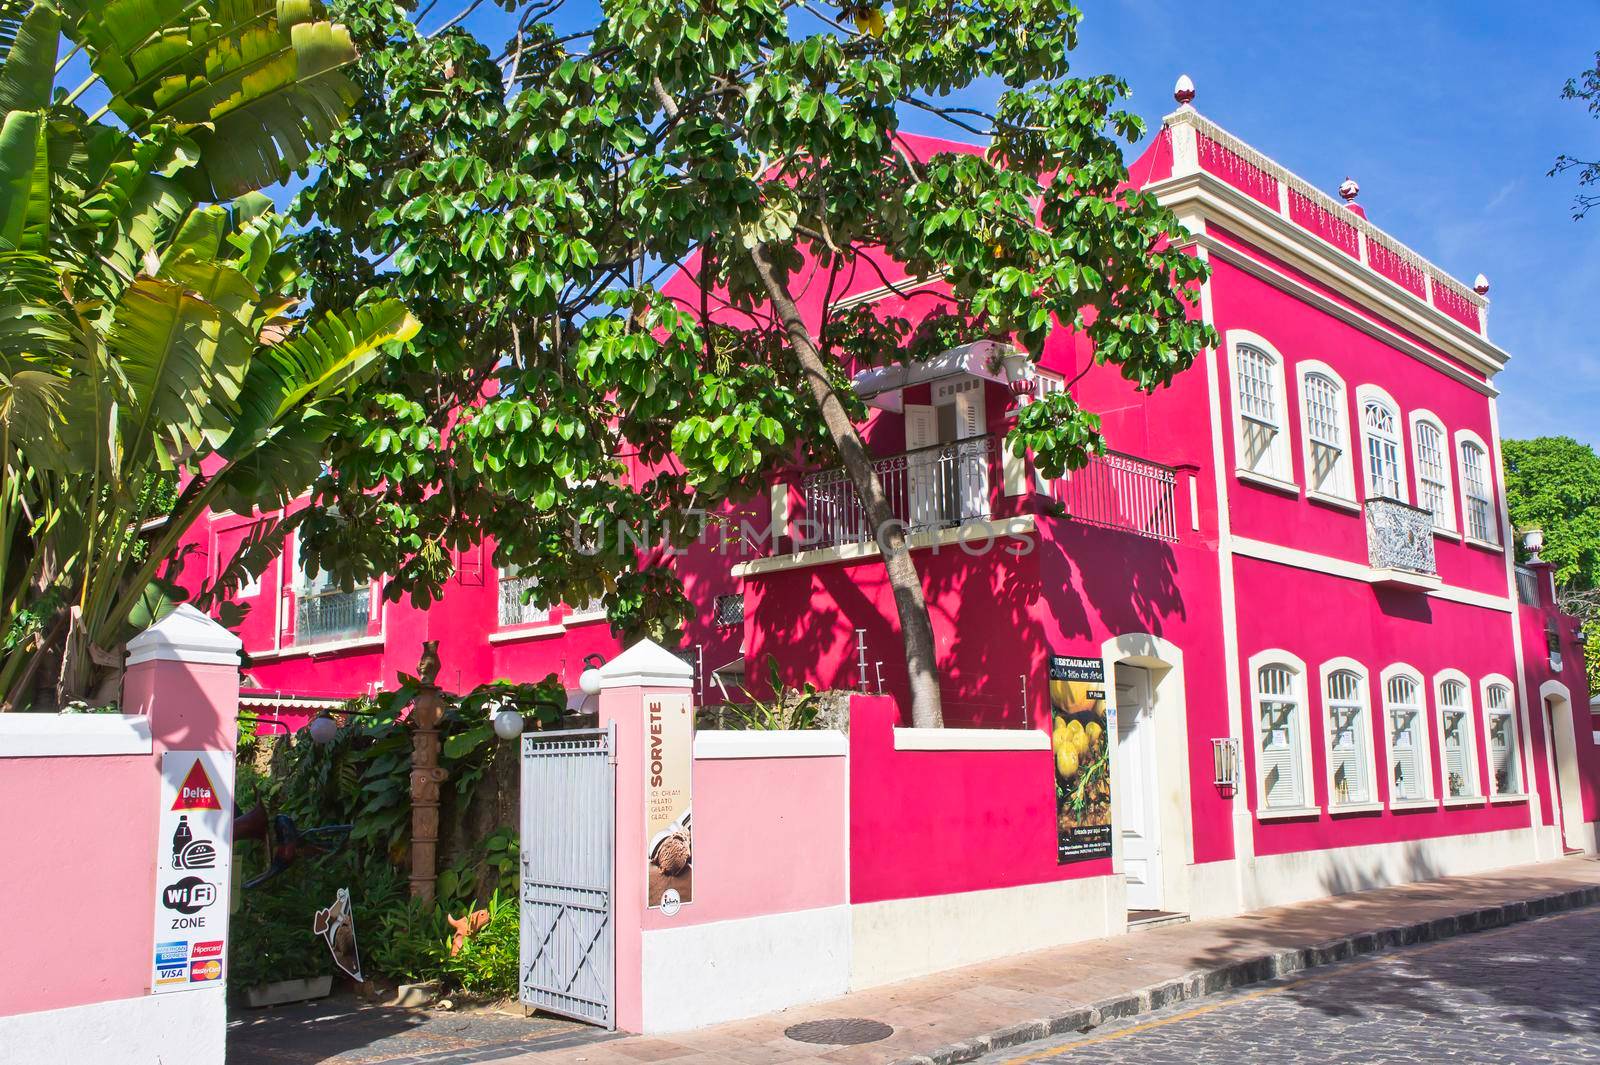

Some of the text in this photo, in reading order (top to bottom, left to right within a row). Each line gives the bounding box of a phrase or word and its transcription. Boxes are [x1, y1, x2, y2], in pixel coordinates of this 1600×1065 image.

[1054, 658, 1100, 668] RESTAURANTE
[650, 701, 662, 787] SORVETE
[183, 787, 211, 798] Delta
[171, 917, 206, 930] ZONE
[194, 944, 222, 954] Hipercard
[161, 969, 183, 978] VISA
[191, 965, 221, 975] MasterCard
